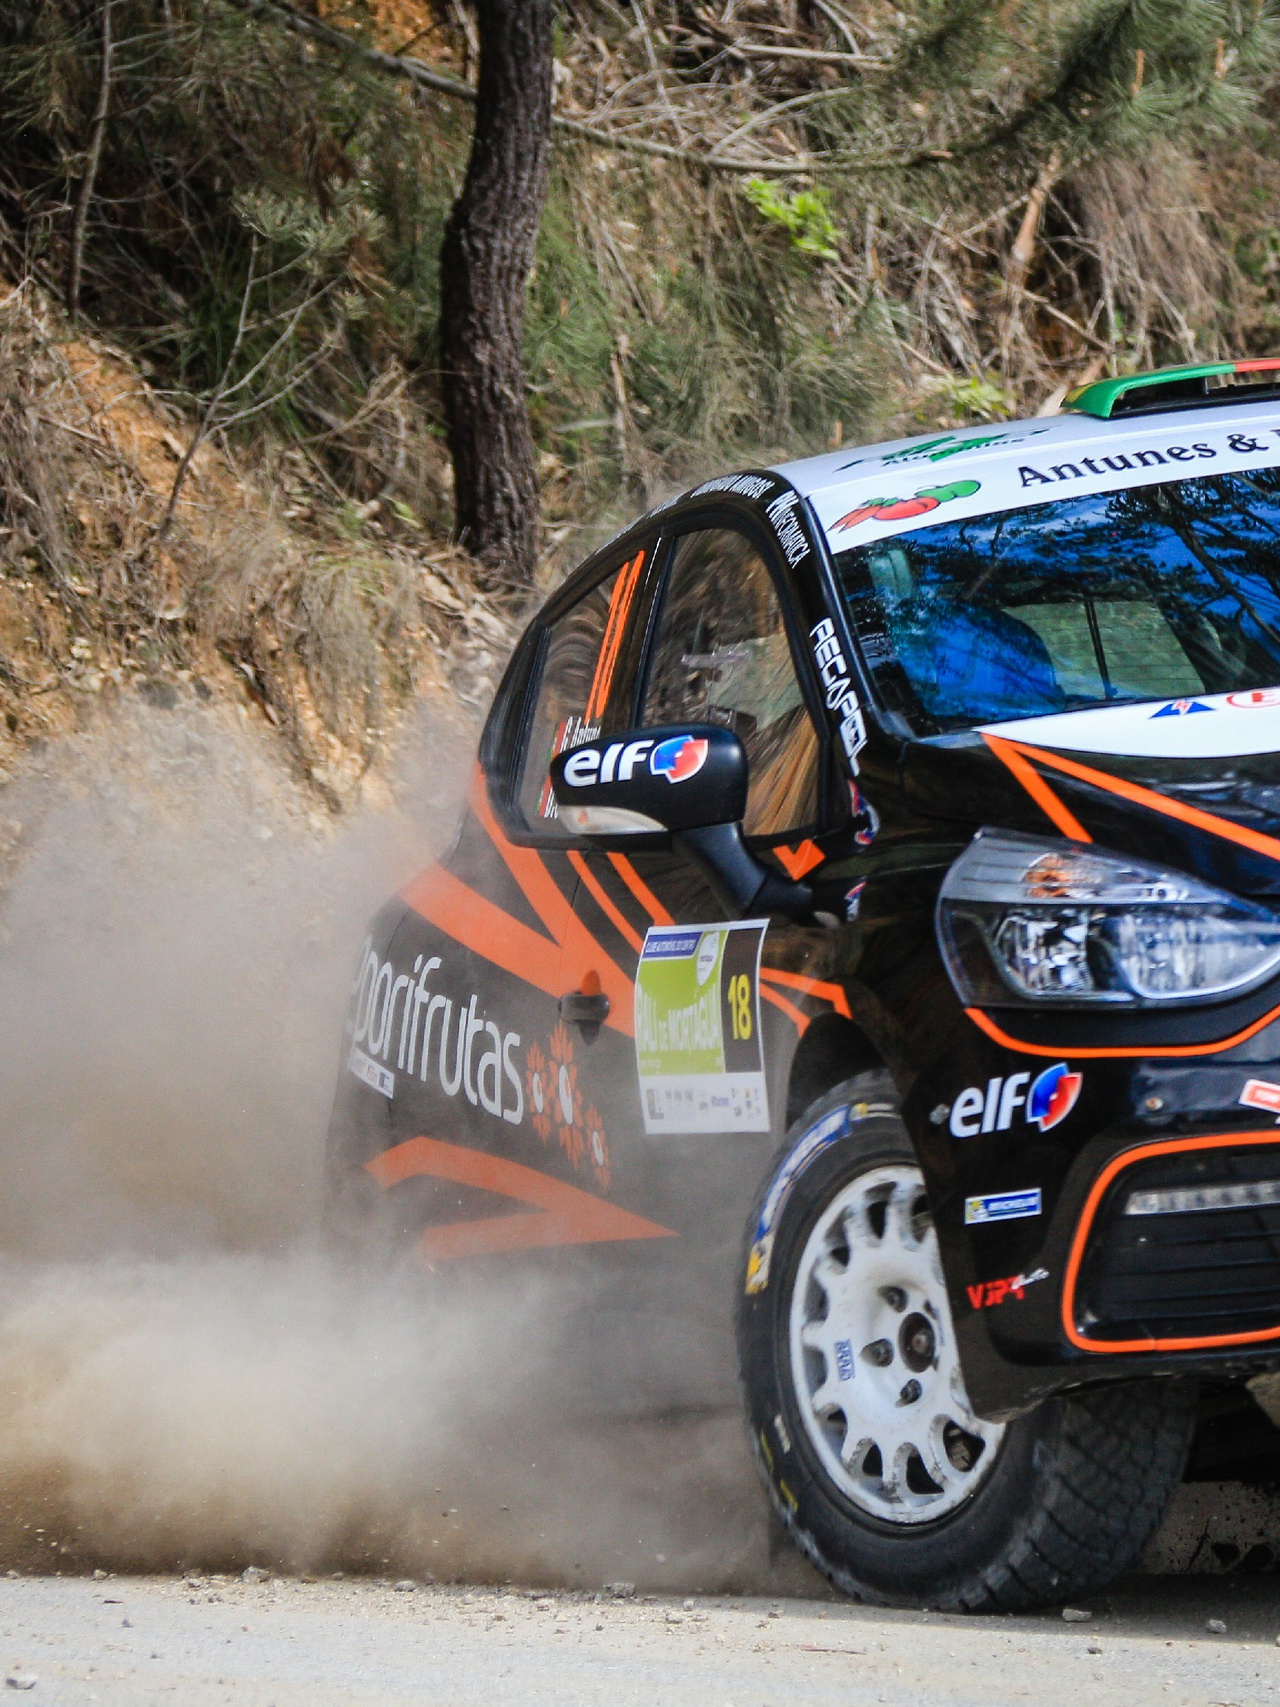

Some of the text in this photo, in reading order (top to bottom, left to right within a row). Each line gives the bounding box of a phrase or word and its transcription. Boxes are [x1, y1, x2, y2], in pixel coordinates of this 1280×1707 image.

[1018, 442, 1217, 488] Antunes
[1226, 432, 1269, 453] &
[563, 738, 655, 788] elf
[727, 973, 753, 1041] 18
[950, 1071, 1031, 1138] elf
